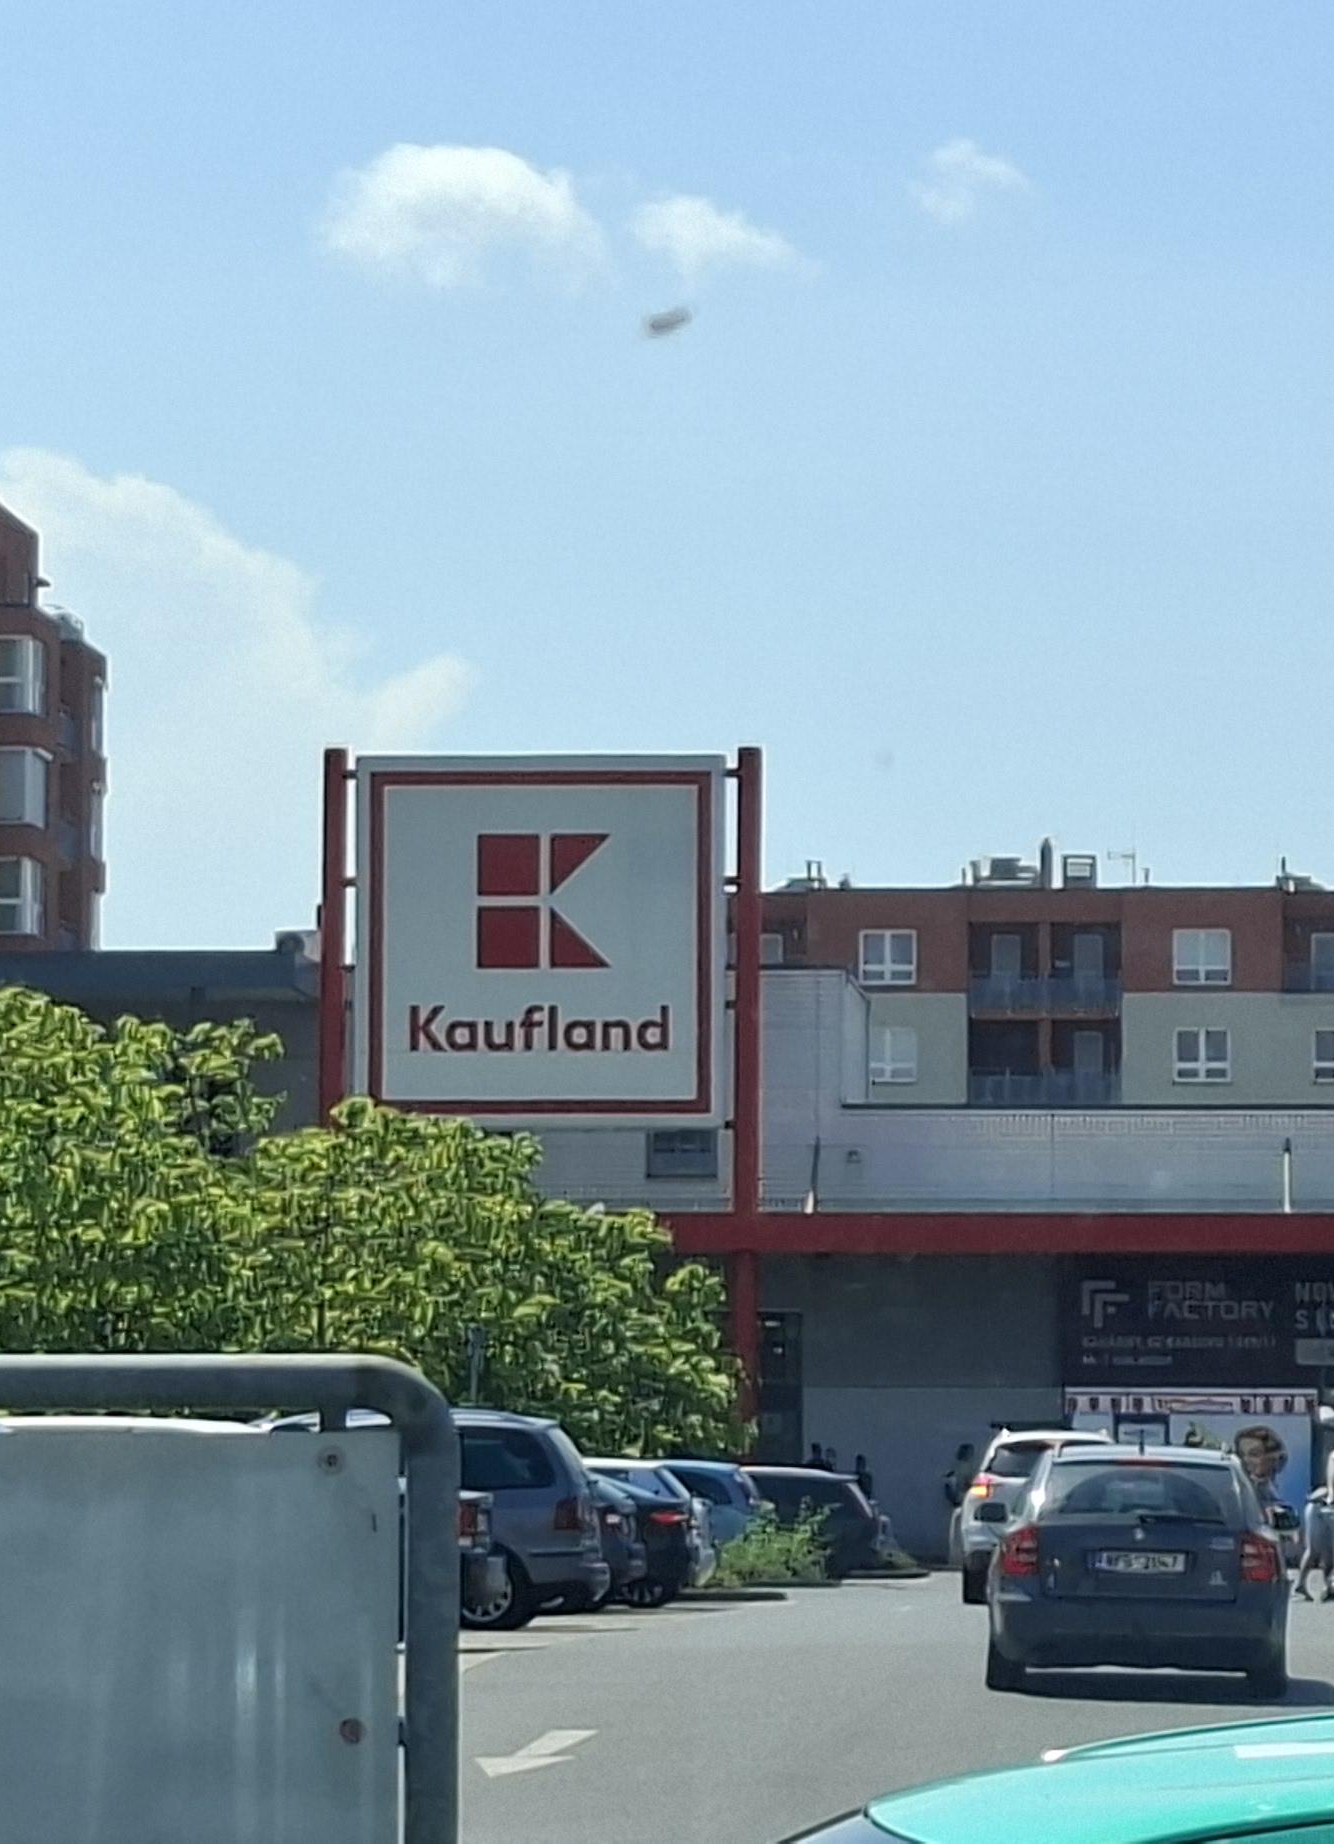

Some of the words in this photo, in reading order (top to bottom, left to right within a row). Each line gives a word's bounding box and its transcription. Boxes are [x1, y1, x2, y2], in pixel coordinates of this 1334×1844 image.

[408, 1003, 670, 1052] Kaufland
[1147, 1280, 1227, 1301] FORM
[1147, 1300, 1275, 1321] FACTORY
